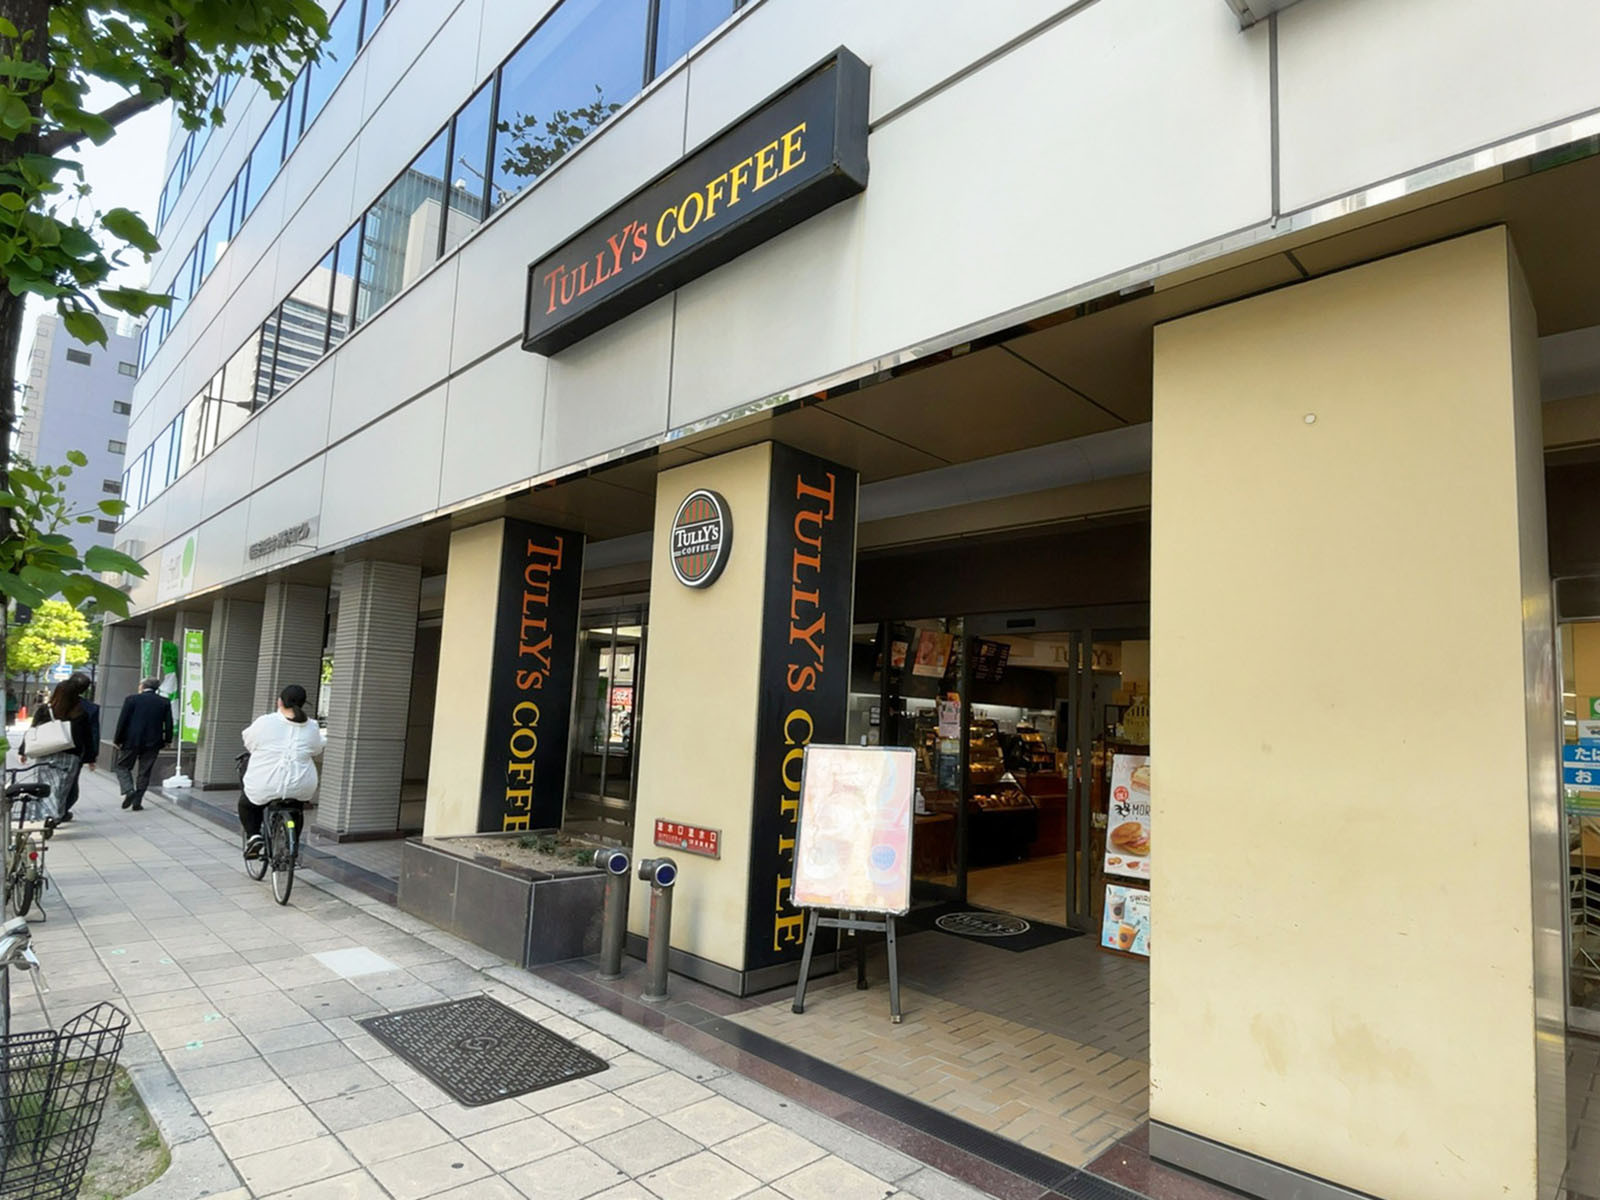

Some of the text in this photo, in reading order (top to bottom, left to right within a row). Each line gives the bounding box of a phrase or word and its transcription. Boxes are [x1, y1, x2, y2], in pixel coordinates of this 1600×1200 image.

[543, 121, 807, 316] TULLY'S COFFEE
[516, 535, 564, 691] TULLY'S
[681, 543, 710, 556] COFFEE
[785, 472, 836, 694] TULLY'S
